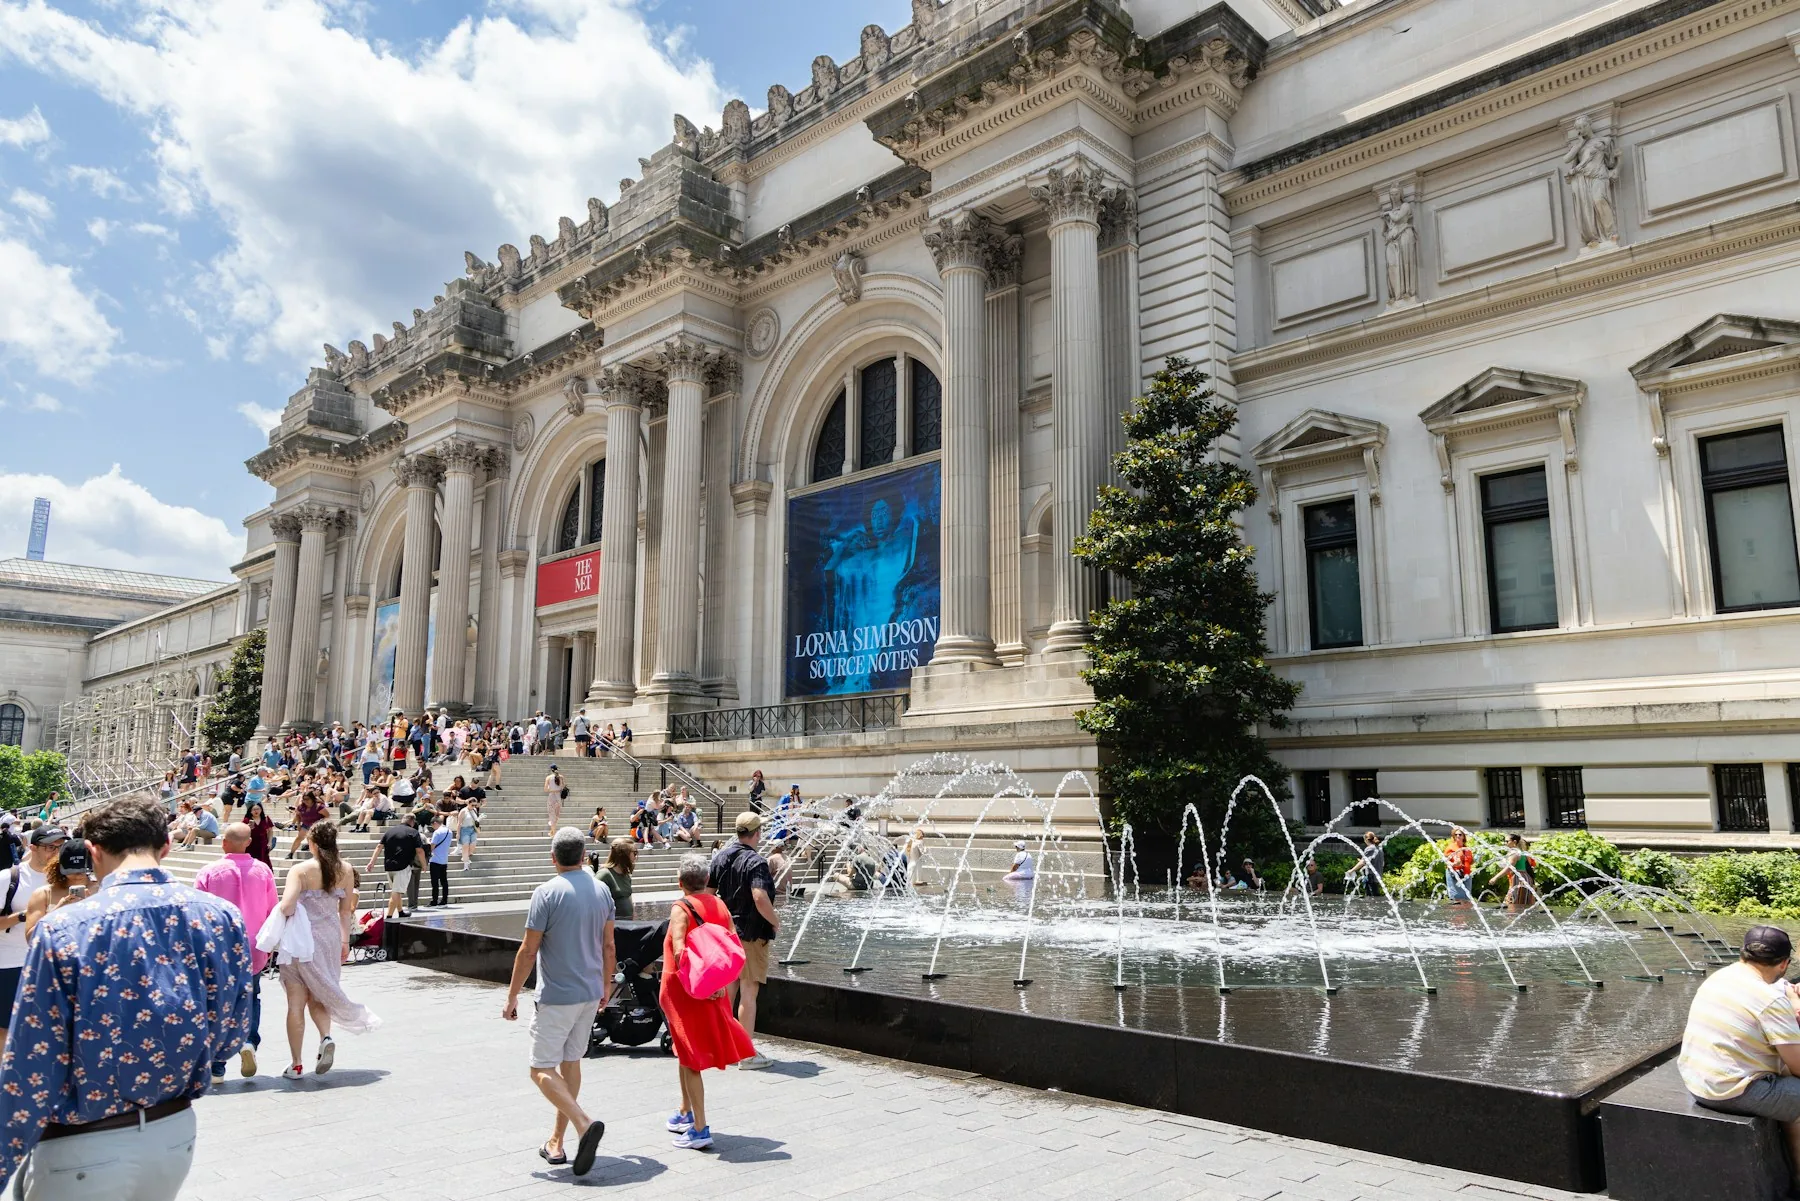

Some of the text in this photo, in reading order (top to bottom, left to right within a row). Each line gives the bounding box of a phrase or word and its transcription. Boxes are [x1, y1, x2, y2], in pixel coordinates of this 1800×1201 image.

[576, 558, 592, 576] THE
[575, 575, 592, 593] MET
[795, 616, 938, 657] LORNA SIMPSON
[810, 649, 918, 679] SOURCE NOTES
